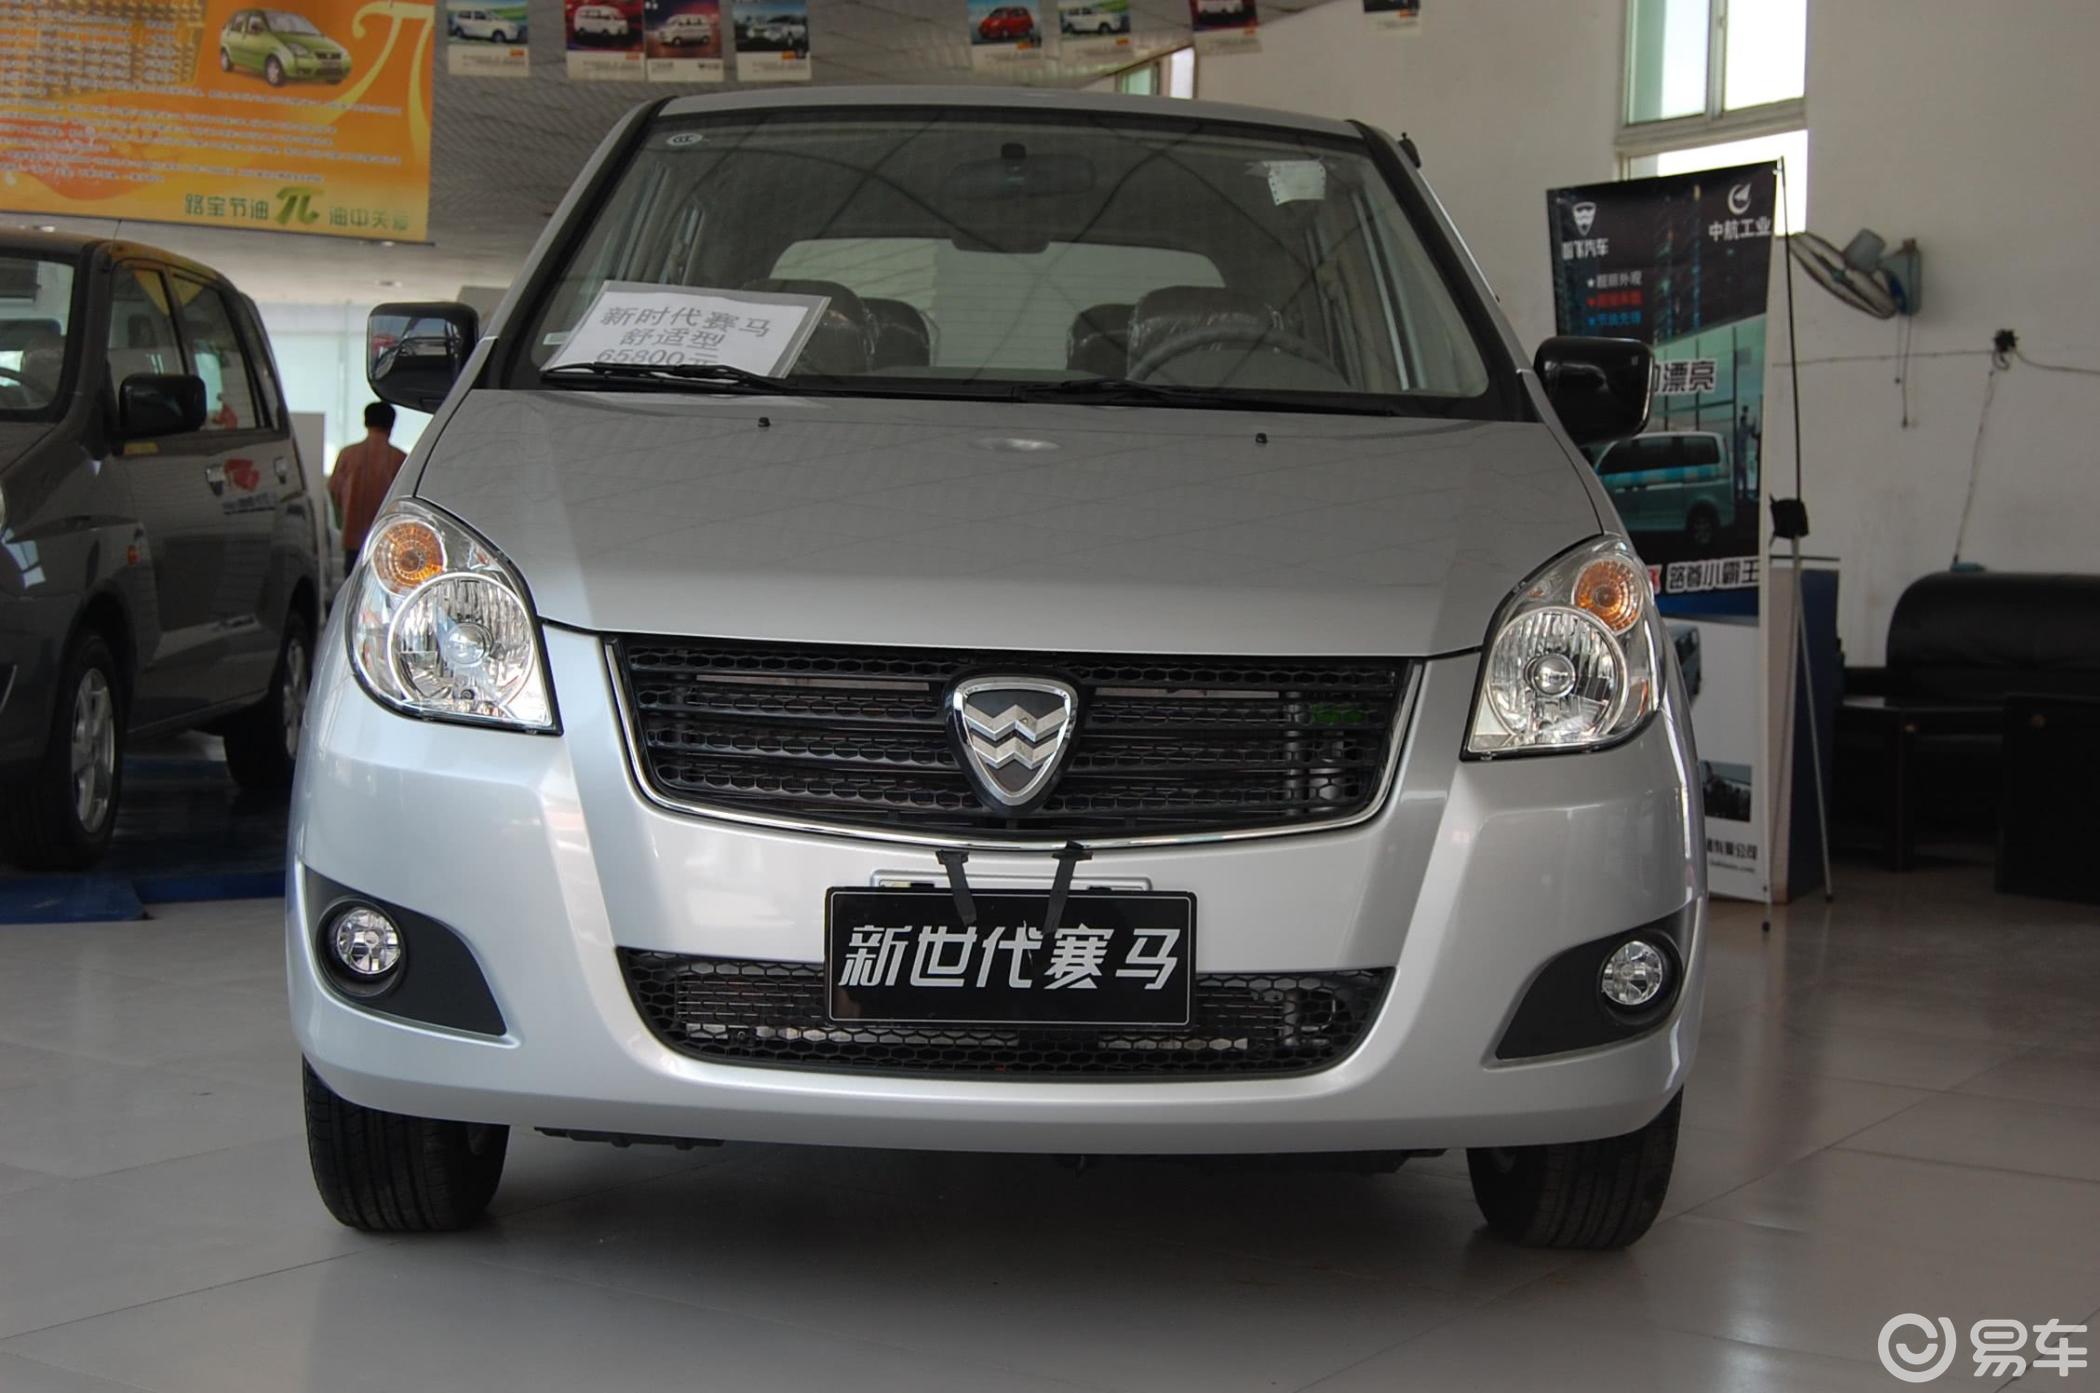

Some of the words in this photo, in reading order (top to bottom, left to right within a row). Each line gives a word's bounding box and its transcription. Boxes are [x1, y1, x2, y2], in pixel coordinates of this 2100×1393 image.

[1708, 216, 1772, 242] 中航工业
[600, 306, 771, 337] 新时代赛马
[619, 328, 726, 350] 舒适型
[838, 923, 1181, 990] 新世代赛马
